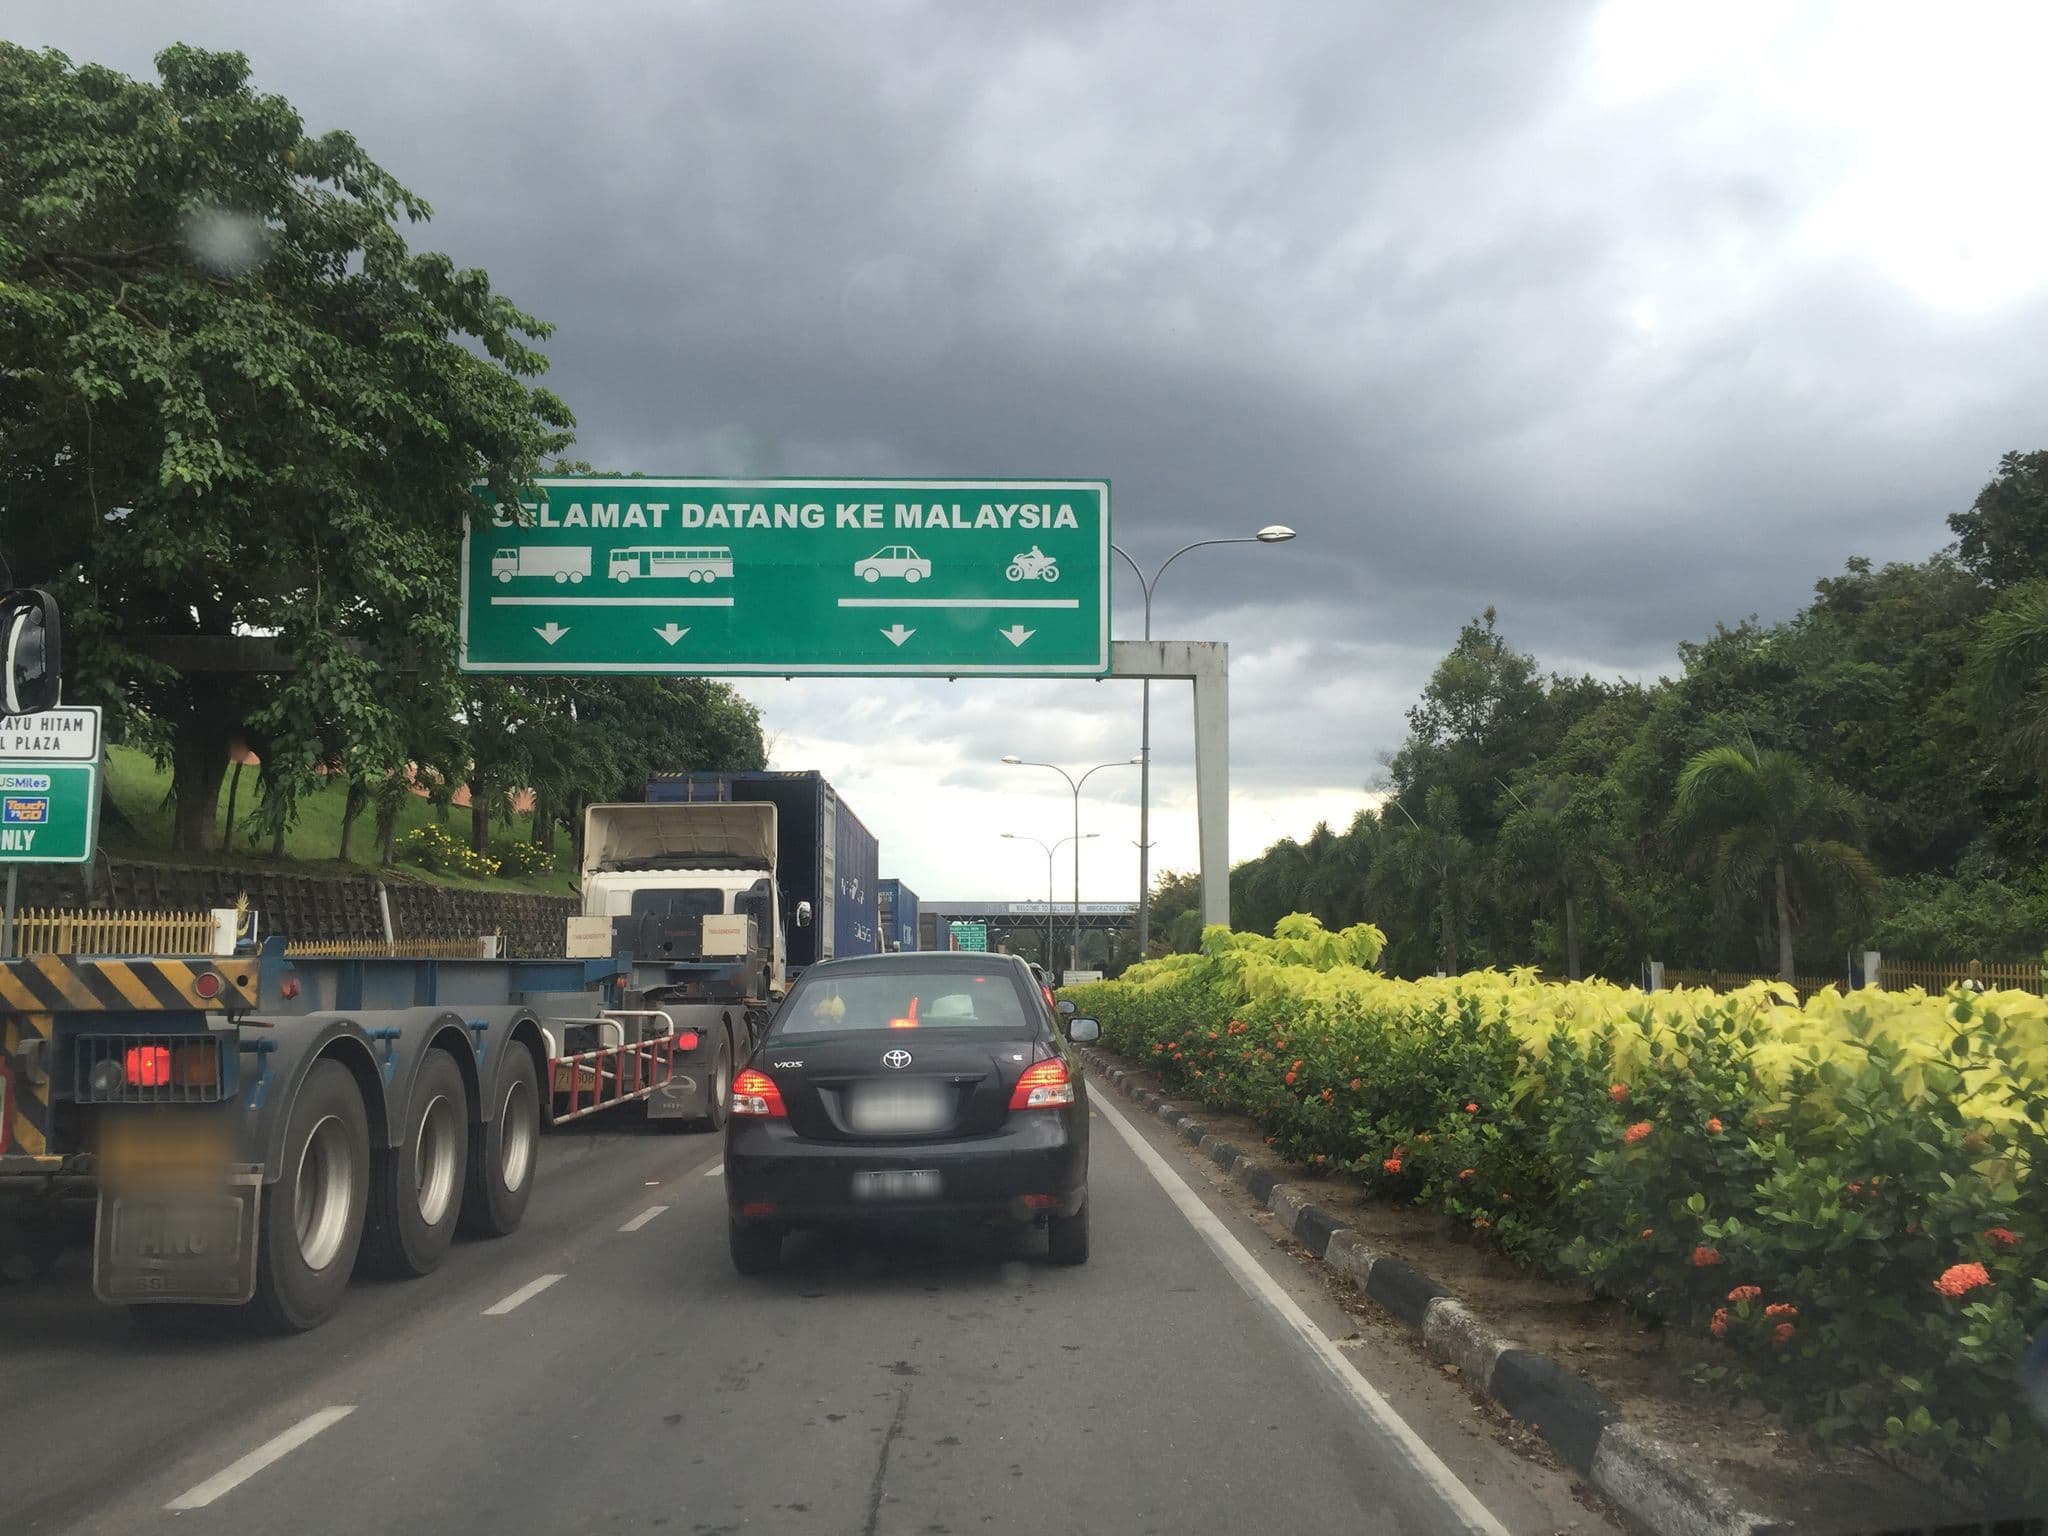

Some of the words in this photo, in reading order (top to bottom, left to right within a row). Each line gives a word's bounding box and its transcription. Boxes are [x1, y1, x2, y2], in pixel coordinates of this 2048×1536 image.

[492, 503, 670, 528] SELAMAT
[681, 503, 825, 529] DATANG
[836, 504, 884, 529] KE
[895, 504, 1079, 529] MALAYSIA
[0, 717, 32, 731] AYU
[41, 718, 83, 732] HITAM
[16, 737, 61, 750] PLAZA
[7, 800, 46, 810] Touch
[774, 1061, 804, 1069] VIOS
